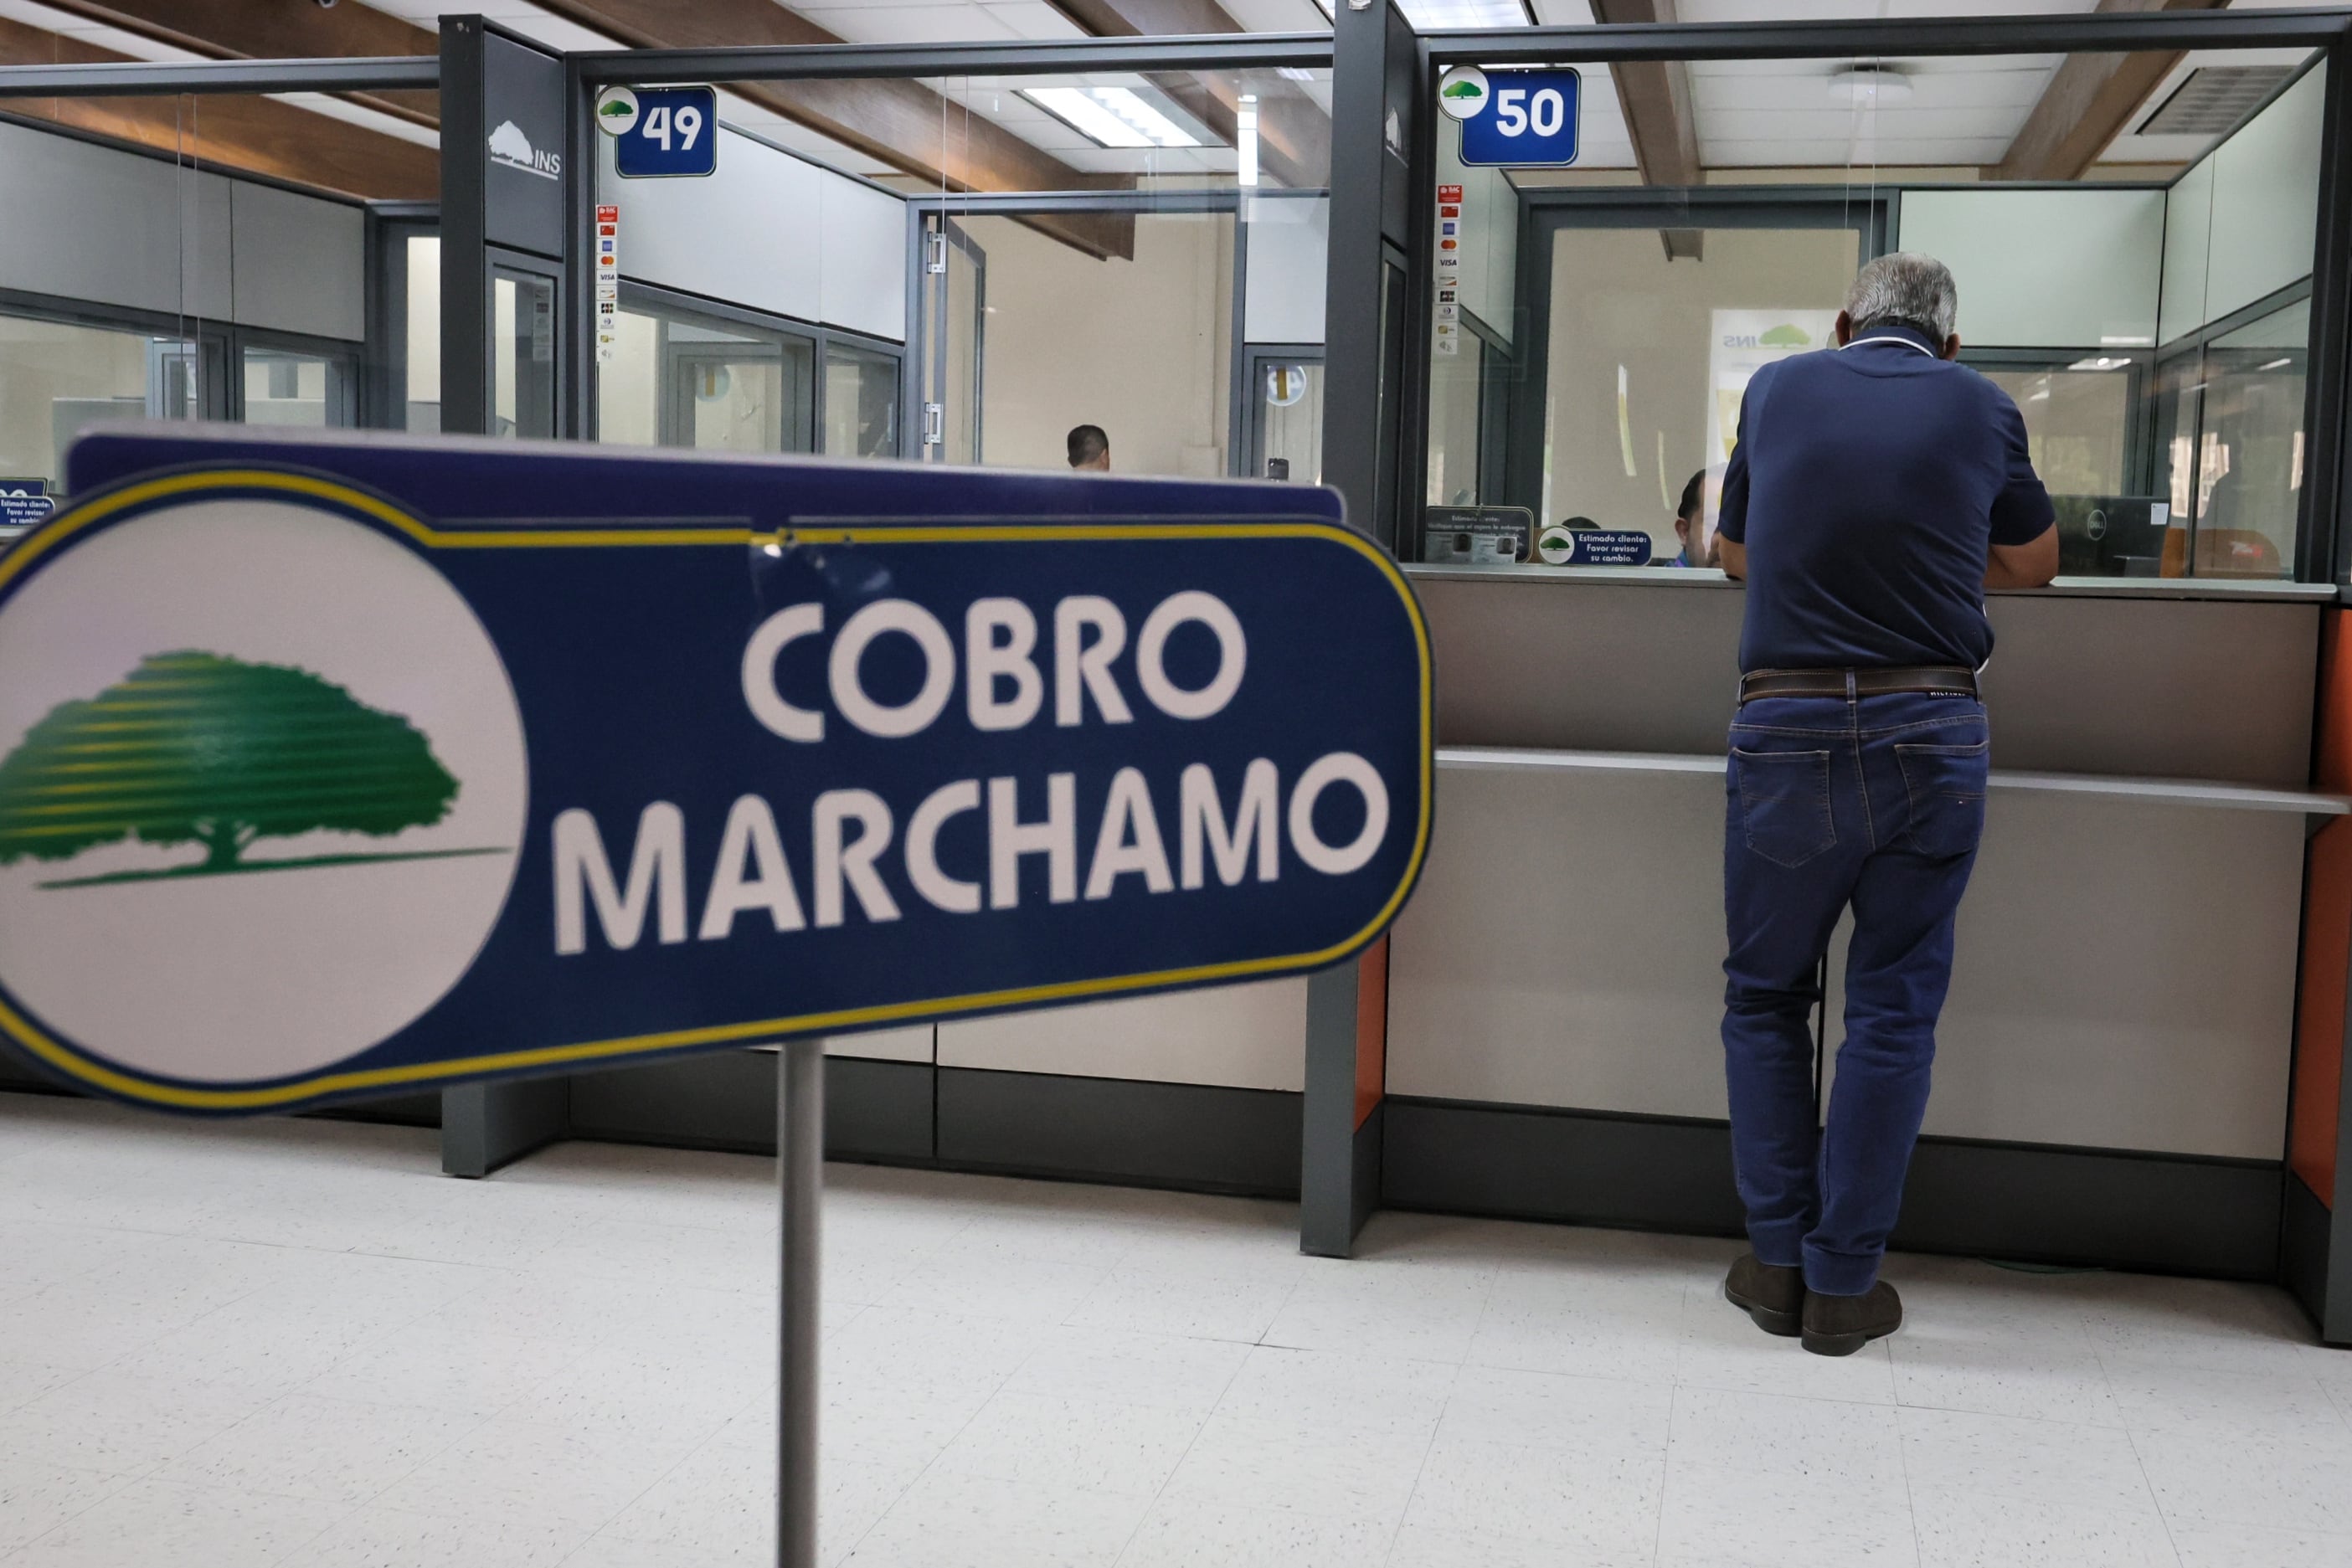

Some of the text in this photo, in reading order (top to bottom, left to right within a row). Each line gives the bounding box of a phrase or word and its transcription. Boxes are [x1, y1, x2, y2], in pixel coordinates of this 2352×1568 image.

[642, 105, 703, 152] 49
[1495, 88, 1564, 137] 50
[534, 149, 561, 175] INS
[1578, 533, 1647, 543] Estimado cliente:
[1587, 543, 1639, 553] Favor revisar
[1602, 553, 1634, 563] cambio.
[742, 589, 1247, 743] COBRO
[551, 751, 1390, 956] MARCHAMO
